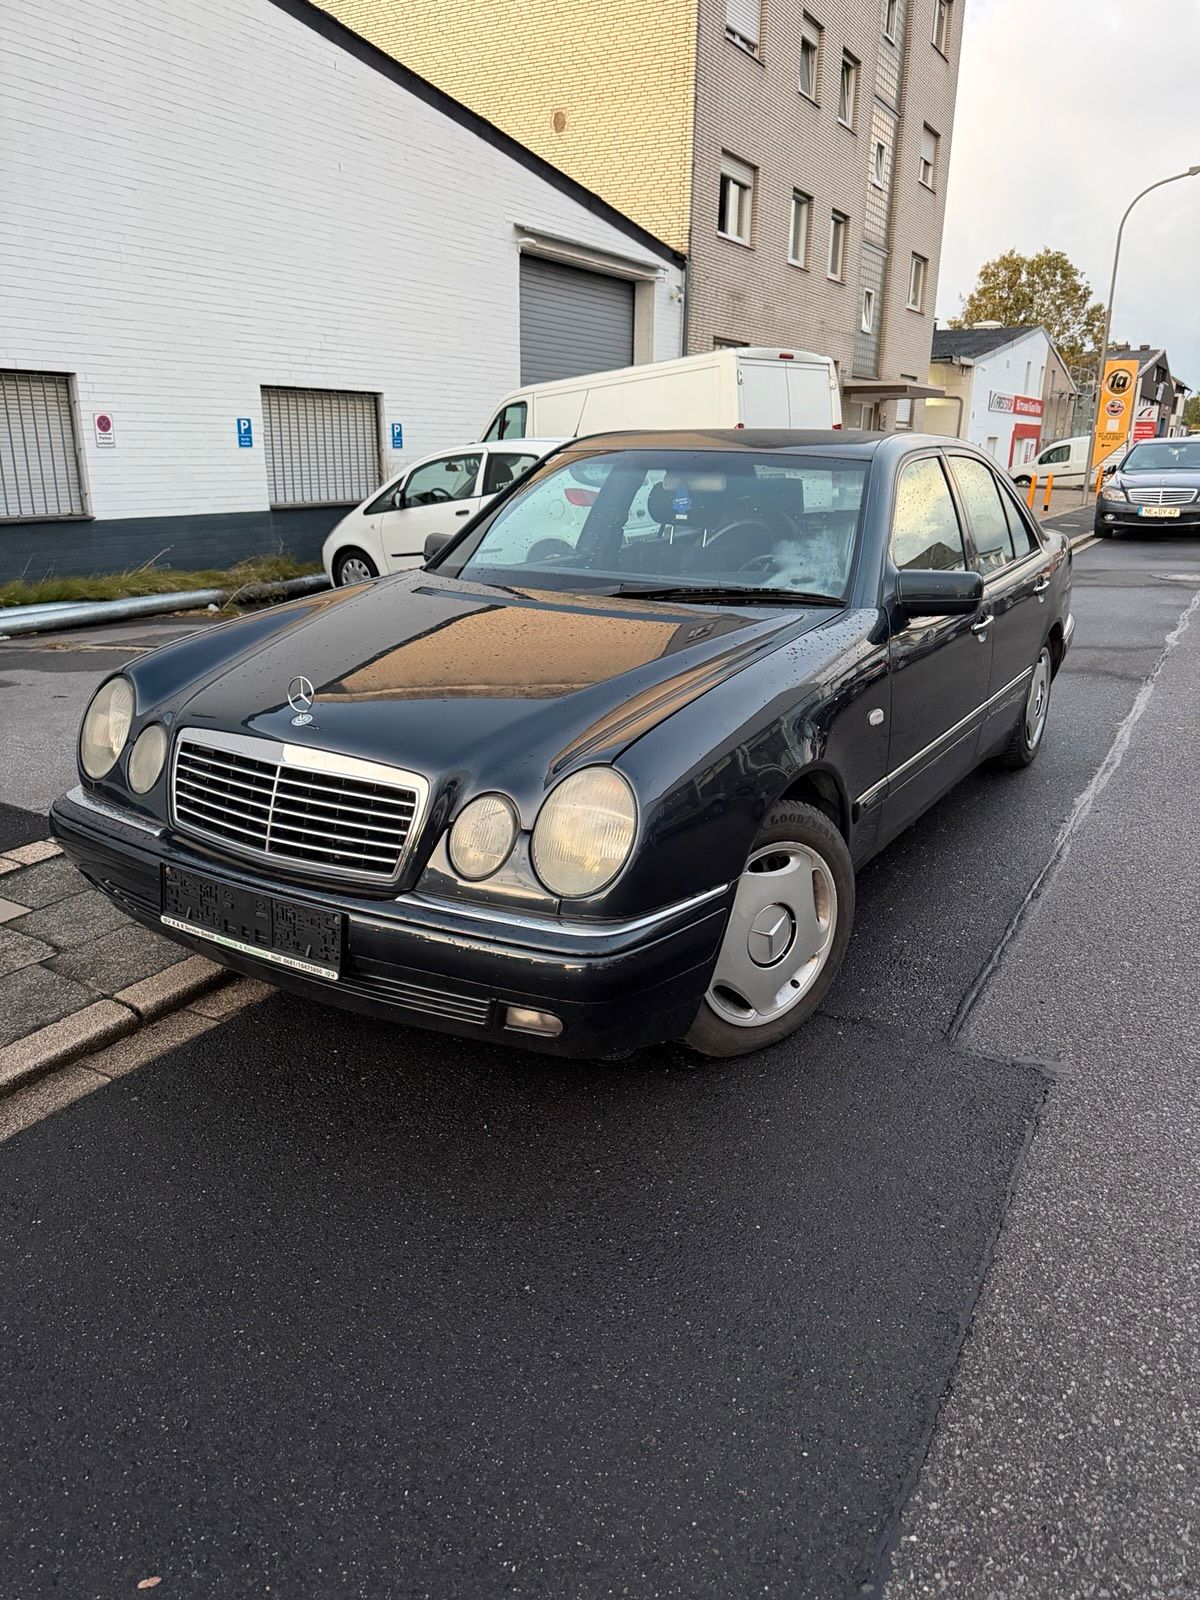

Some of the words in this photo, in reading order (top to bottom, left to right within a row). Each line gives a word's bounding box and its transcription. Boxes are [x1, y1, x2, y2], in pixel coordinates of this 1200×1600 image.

[240, 420, 249, 434] P
[394, 425, 401, 437] P
[200, 930, 215, 940] GmbH
